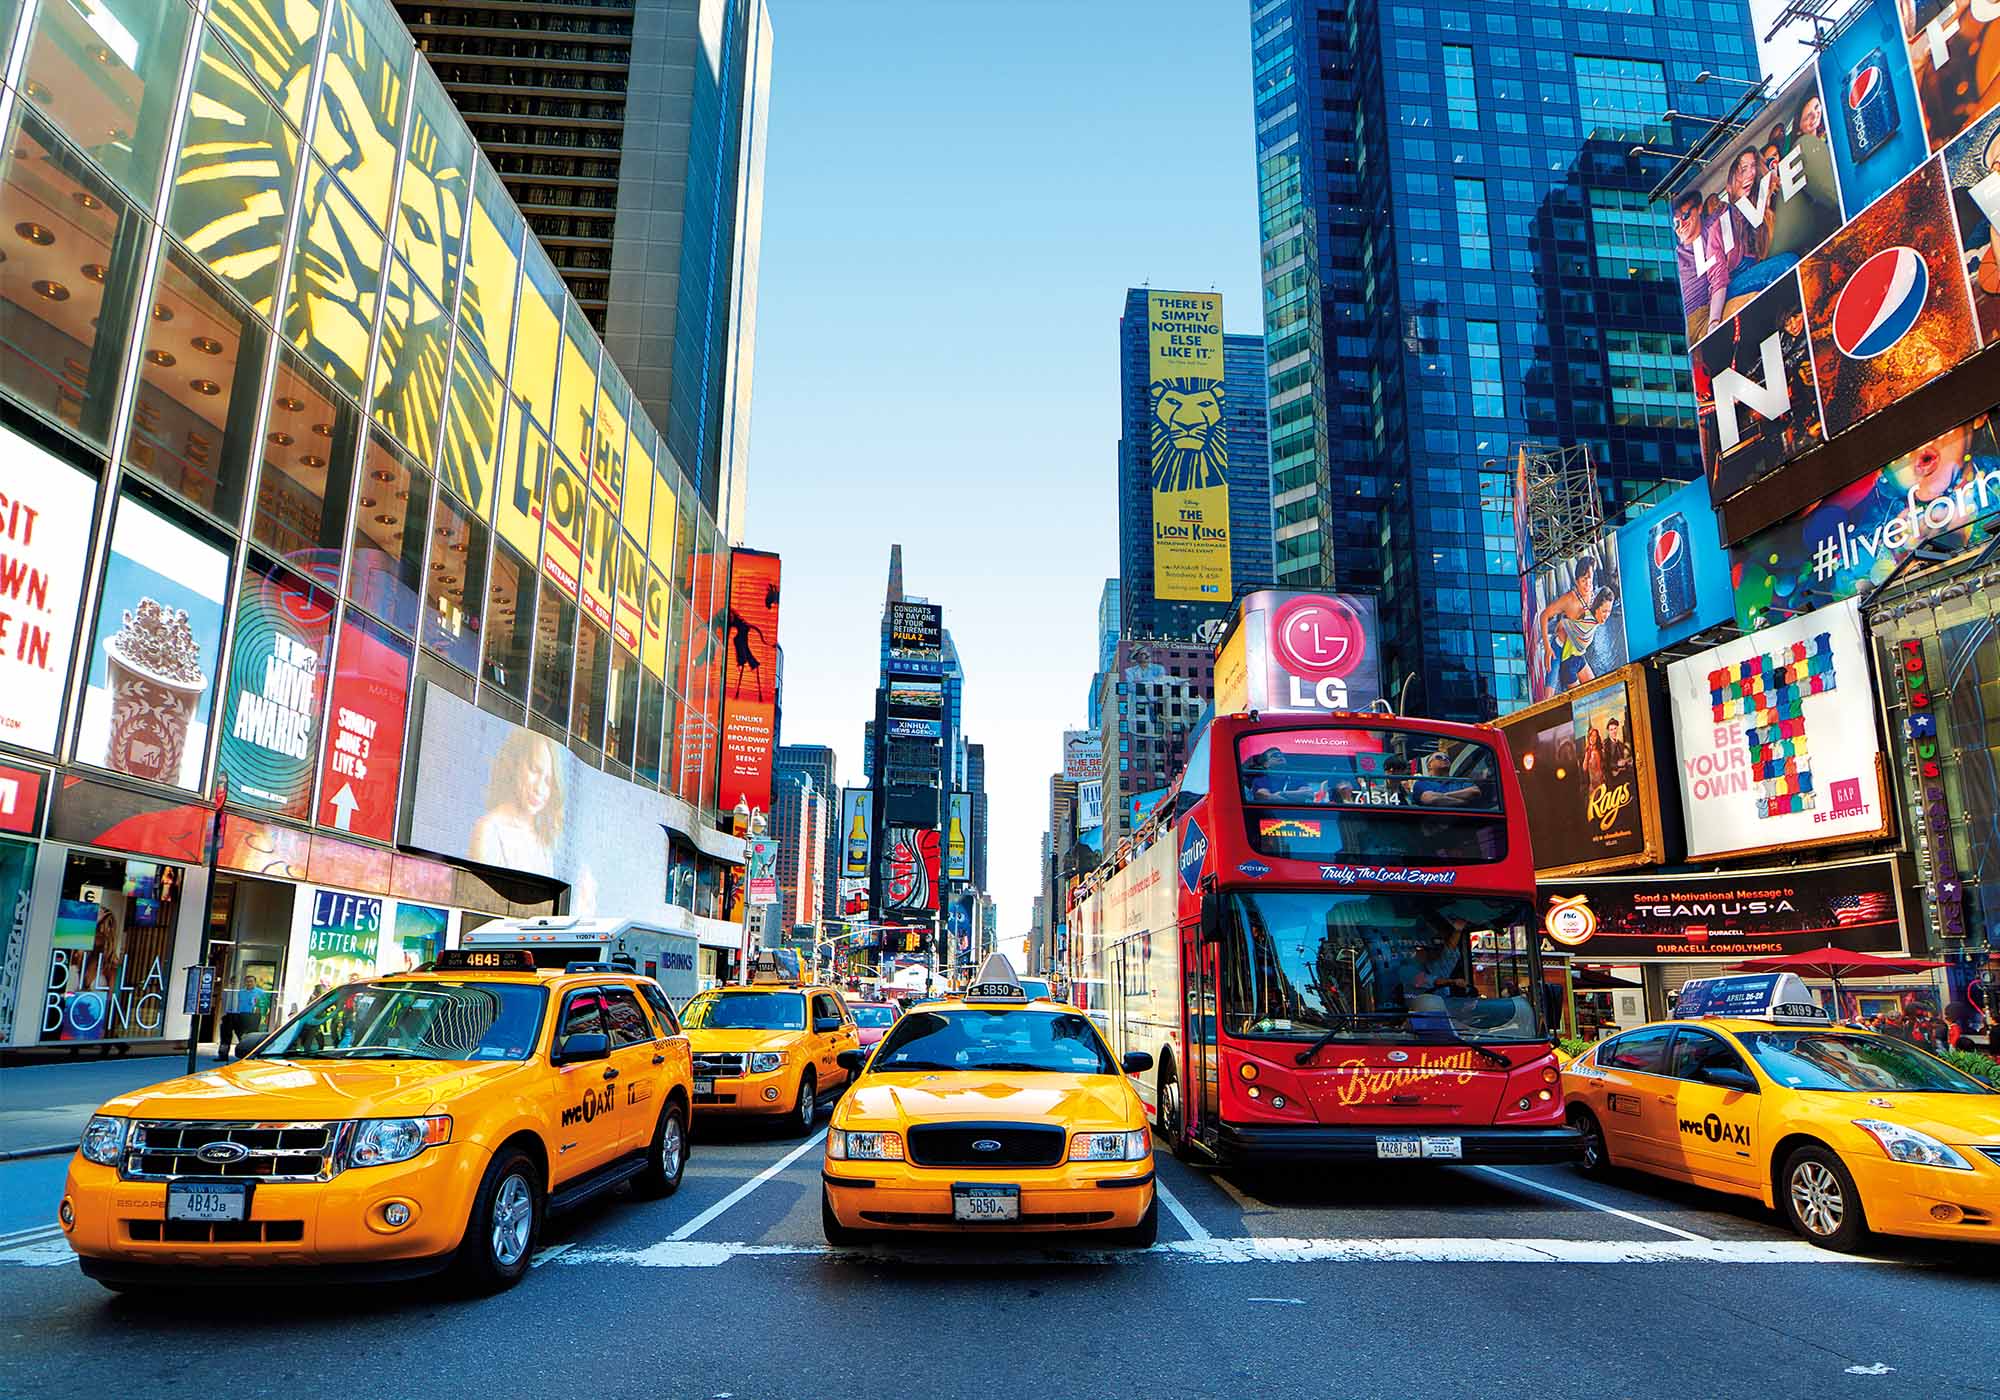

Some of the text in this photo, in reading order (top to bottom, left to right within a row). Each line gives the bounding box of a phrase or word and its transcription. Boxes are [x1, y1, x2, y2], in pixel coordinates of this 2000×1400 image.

[1853, 108, 1868, 147] pepsi
[1692, 144, 1808, 278] LIVE
[1202, 300, 1214, 311] IS
[1161, 310, 1209, 322] SIMPLY
[1151, 322, 1219, 335] NOTHING
[1170, 334, 1202, 346] ELSE
[1160, 346, 1192, 358] LIKE
[578, 404, 622, 496] THE
[513, 395, 662, 628] LION KING
[1179, 509, 1203, 519] THE
[1156, 521, 1227, 540] LION KING
[545, 556, 577, 592] ENTRANCE
[582, 594, 594, 608] ON
[1656, 570, 1670, 613] pepsi
[894, 605, 931, 614] CONGRATS
[894, 613, 904, 621] ON
[905, 613, 920, 622] DAY
[893, 619, 924, 629] OF YOUR
[893, 625, 938, 636] RETIREMENT
[893, 632, 917, 641] PAULA
[17, 621, 54, 672] IN.
[1289, 675, 1349, 709] LG
[1901, 640, 1932, 708] TOYS
[1919, 743, 1939, 778] US
[233, 690, 311, 760] AWARDS
[338, 707, 376, 739] SUNDAY
[727, 724, 769, 735] ANYTHING
[898, 721, 930, 731] XINHUA
[727, 735, 769, 744] BROADWAY
[911, 729, 937, 737] AGENCY
[1294, 737, 1349, 746] www.LG.com
[1714, 723, 1742, 749] BE
[336, 730, 370, 759] JUNE 3
[728, 745, 766, 754] HAS EVER
[332, 751, 355, 777] LIVE
[1684, 747, 1745, 779] YOUR
[1693, 771, 1748, 801] OWN
[1836, 787, 1855, 804] GAP
[1351, 790, 1400, 806] 71514
[1587, 781, 1634, 831] Rags
[1814, 804, 1870, 823] BE BRIGHT
[888, 842, 914, 901] Coke
[1319, 865, 1456, 885] Truly, The Local Expert!
[1634, 893, 1660, 903] Send
[1671, 890, 1735, 902] Motivational
[1737, 889, 1781, 901] Message
[1784, 888, 1794, 897] to
[312, 892, 381, 932] LIFE'S
[1634, 903, 1716, 918] TEAM
[309, 930, 377, 956] BETTER IN
[1656, 943, 1783, 954] DURACELL.COM/OLYMPICS
[48, 949, 164, 991] BILLA
[666, 951, 693, 971] BRINKS
[42, 990, 163, 1032] BONG
[1786, 1003, 1813, 1016] 3N99
[1337, 1050, 1477, 1107] Broadway
[561, 1083, 615, 1128] NYC TAXI
[1679, 1112, 1751, 1147] NYC TAXI
[207, 1149, 232, 1158] Ford
[977, 1139, 995, 1149] Ford
[117, 1200, 167, 1209] ESCAPE
